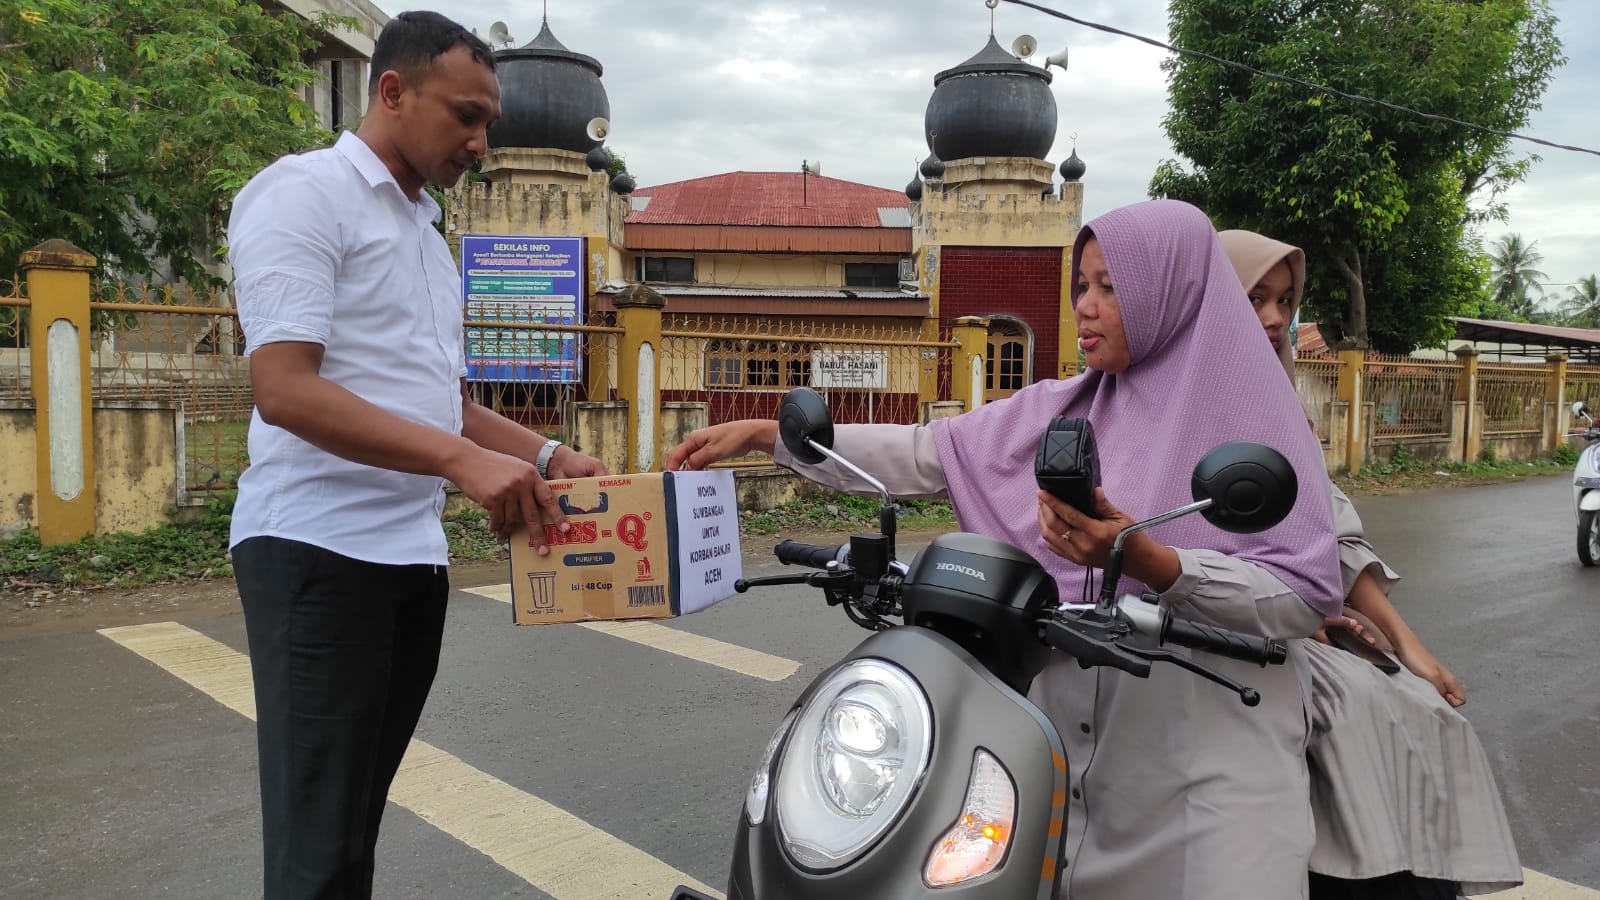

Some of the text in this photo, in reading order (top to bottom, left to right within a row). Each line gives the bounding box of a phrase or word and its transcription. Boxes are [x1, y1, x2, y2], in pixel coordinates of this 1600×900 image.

[494, 243, 550, 252] SEKILAS INFO
[548, 478, 632, 491] MINUM KEMASAN
[697, 485, 717, 497] MOHON
[692, 504, 724, 519] SUMBANGAN
[701, 525, 720, 540] UNTUK
[689, 543, 731, 564] KORBAN BANJIR
[704, 568, 722, 585] ACEH
[935, 562, 987, 582] HONDA
[571, 583, 580, 591] Isi
[585, 582, 595, 590] 48
[596, 582, 613, 592] Cup
